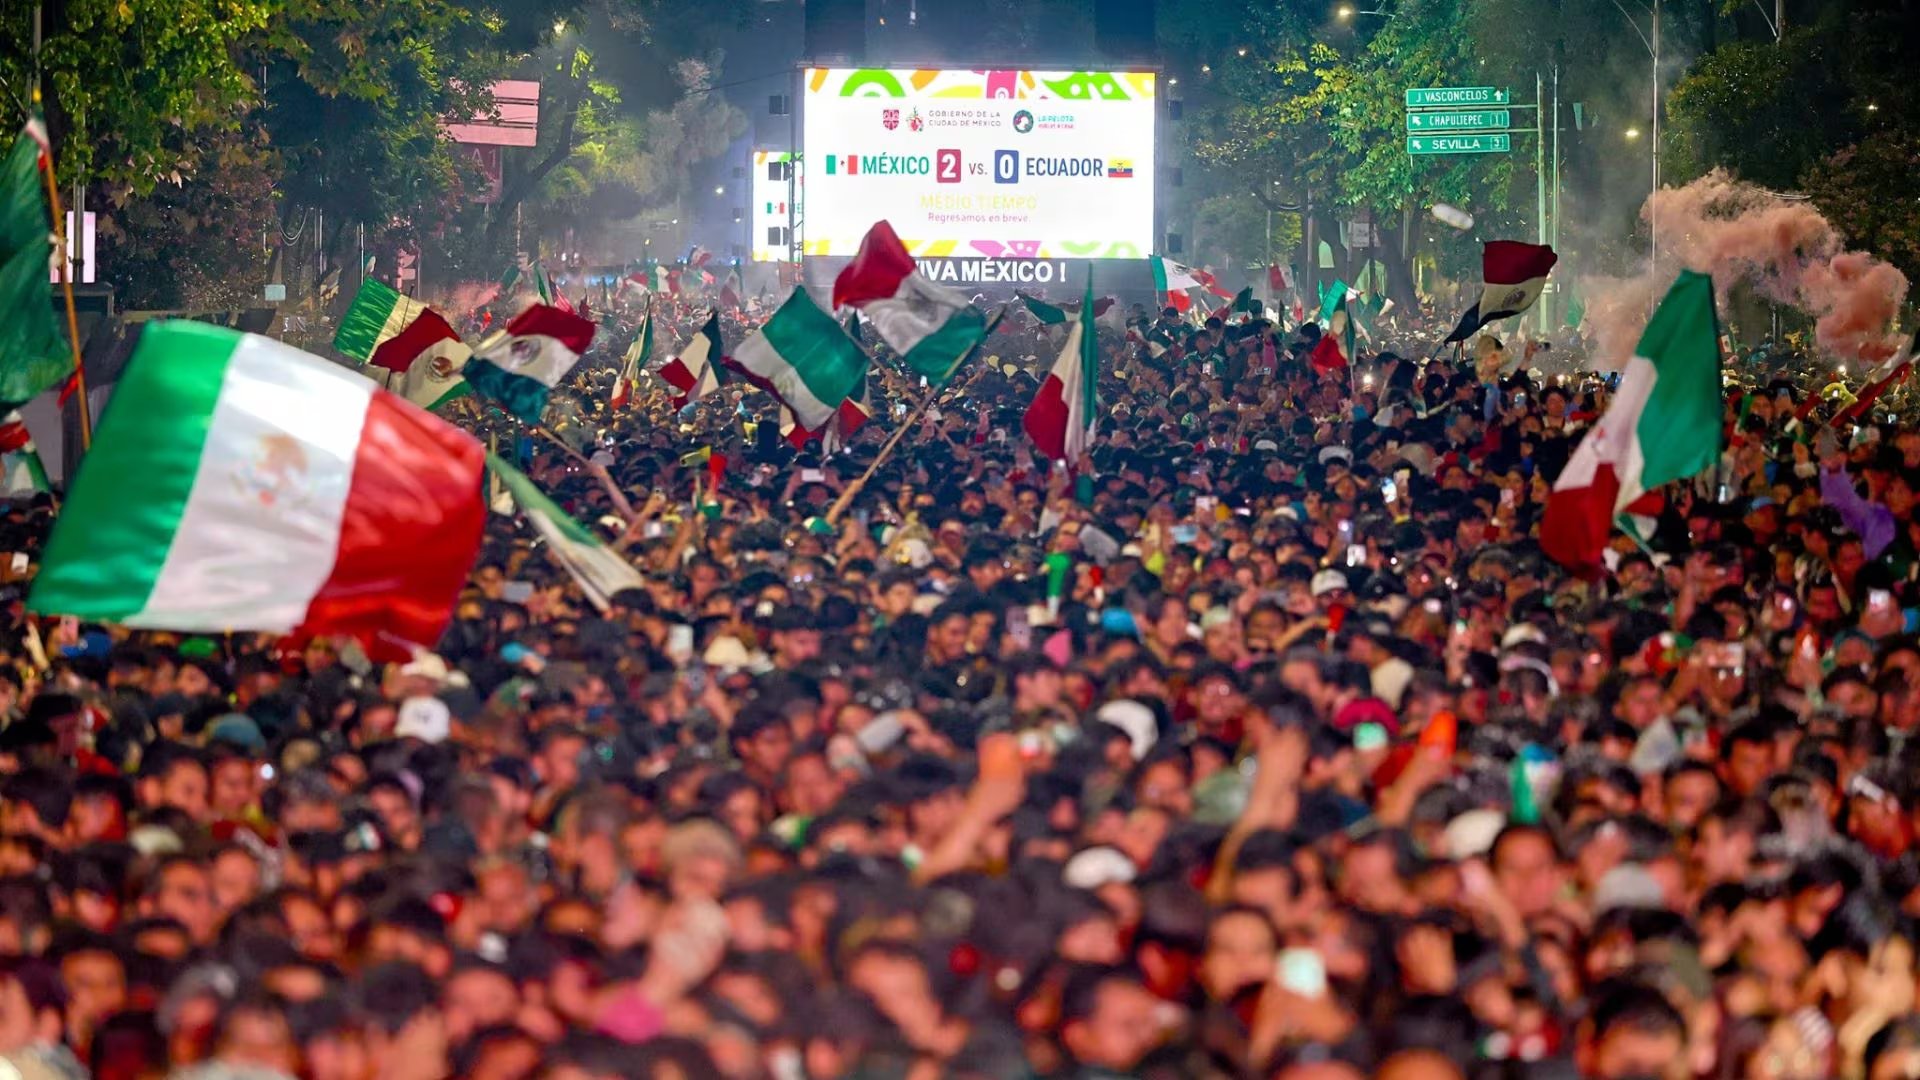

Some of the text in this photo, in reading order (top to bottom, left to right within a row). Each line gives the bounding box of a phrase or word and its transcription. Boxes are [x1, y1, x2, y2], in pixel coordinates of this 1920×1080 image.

[1416, 90, 1488, 103] J VASCONCELOS
[928, 110, 974, 118] GOBIERNO
[1429, 115, 1483, 126] CHAPULTEPEC
[928, 119, 958, 127] CIUDAD
[960, 119, 970, 127] DE
[1432, 139, 1480, 149] SEVILLA
[862, 152, 930, 175] MÉXICO
[941, 153, 957, 179] 2
[999, 153, 1014, 180] 0
[1026, 157, 1103, 177] ECUADOR
[920, 194, 1037, 209] MEDIO TIEMPO
[928, 211, 1031, 224] Regresamos en breve.
[915, 256, 1066, 282] IVA MÉXICO !
